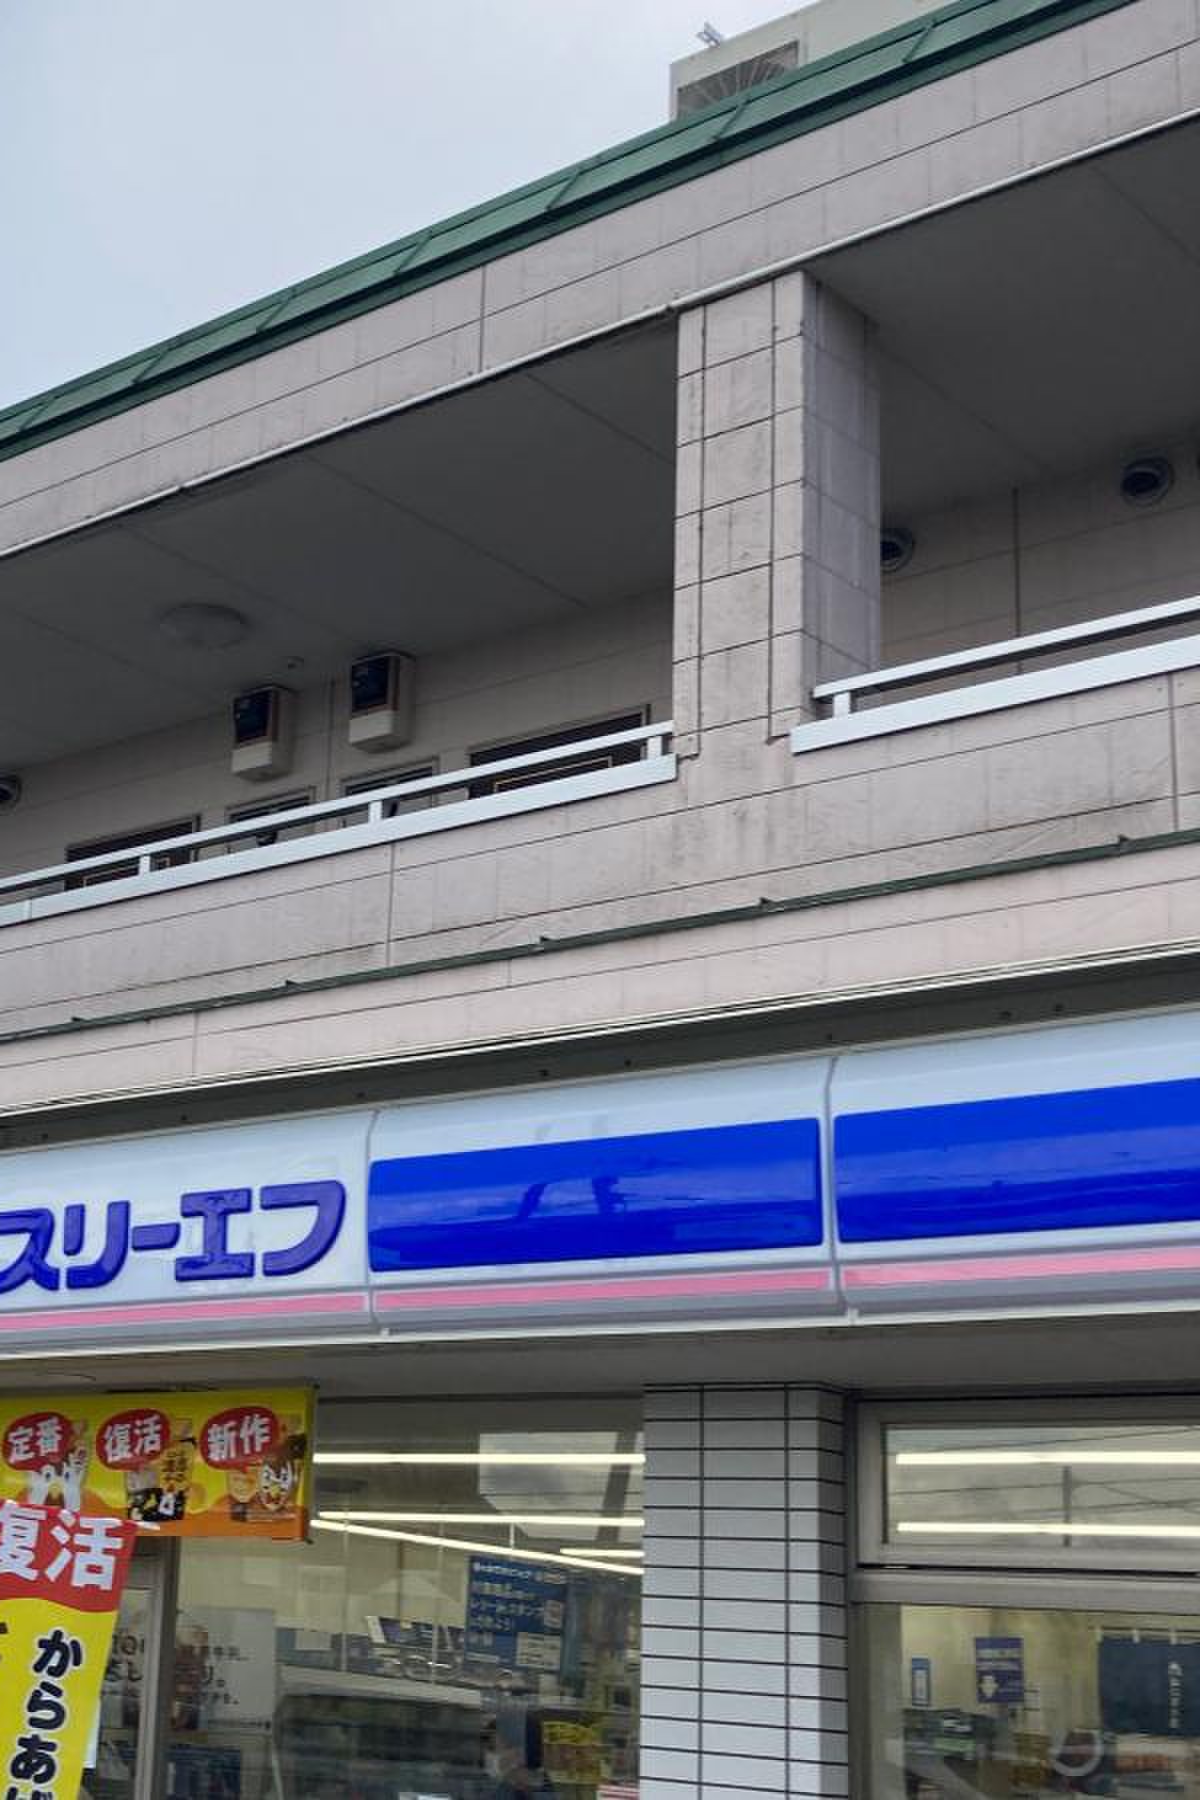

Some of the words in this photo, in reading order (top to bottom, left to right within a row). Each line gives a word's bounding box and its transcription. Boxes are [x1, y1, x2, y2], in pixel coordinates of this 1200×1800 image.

[8, 1415, 63, 1465] 定番
[103, 1414, 163, 1463] 復活
[207, 1413, 273, 1462] 新作
